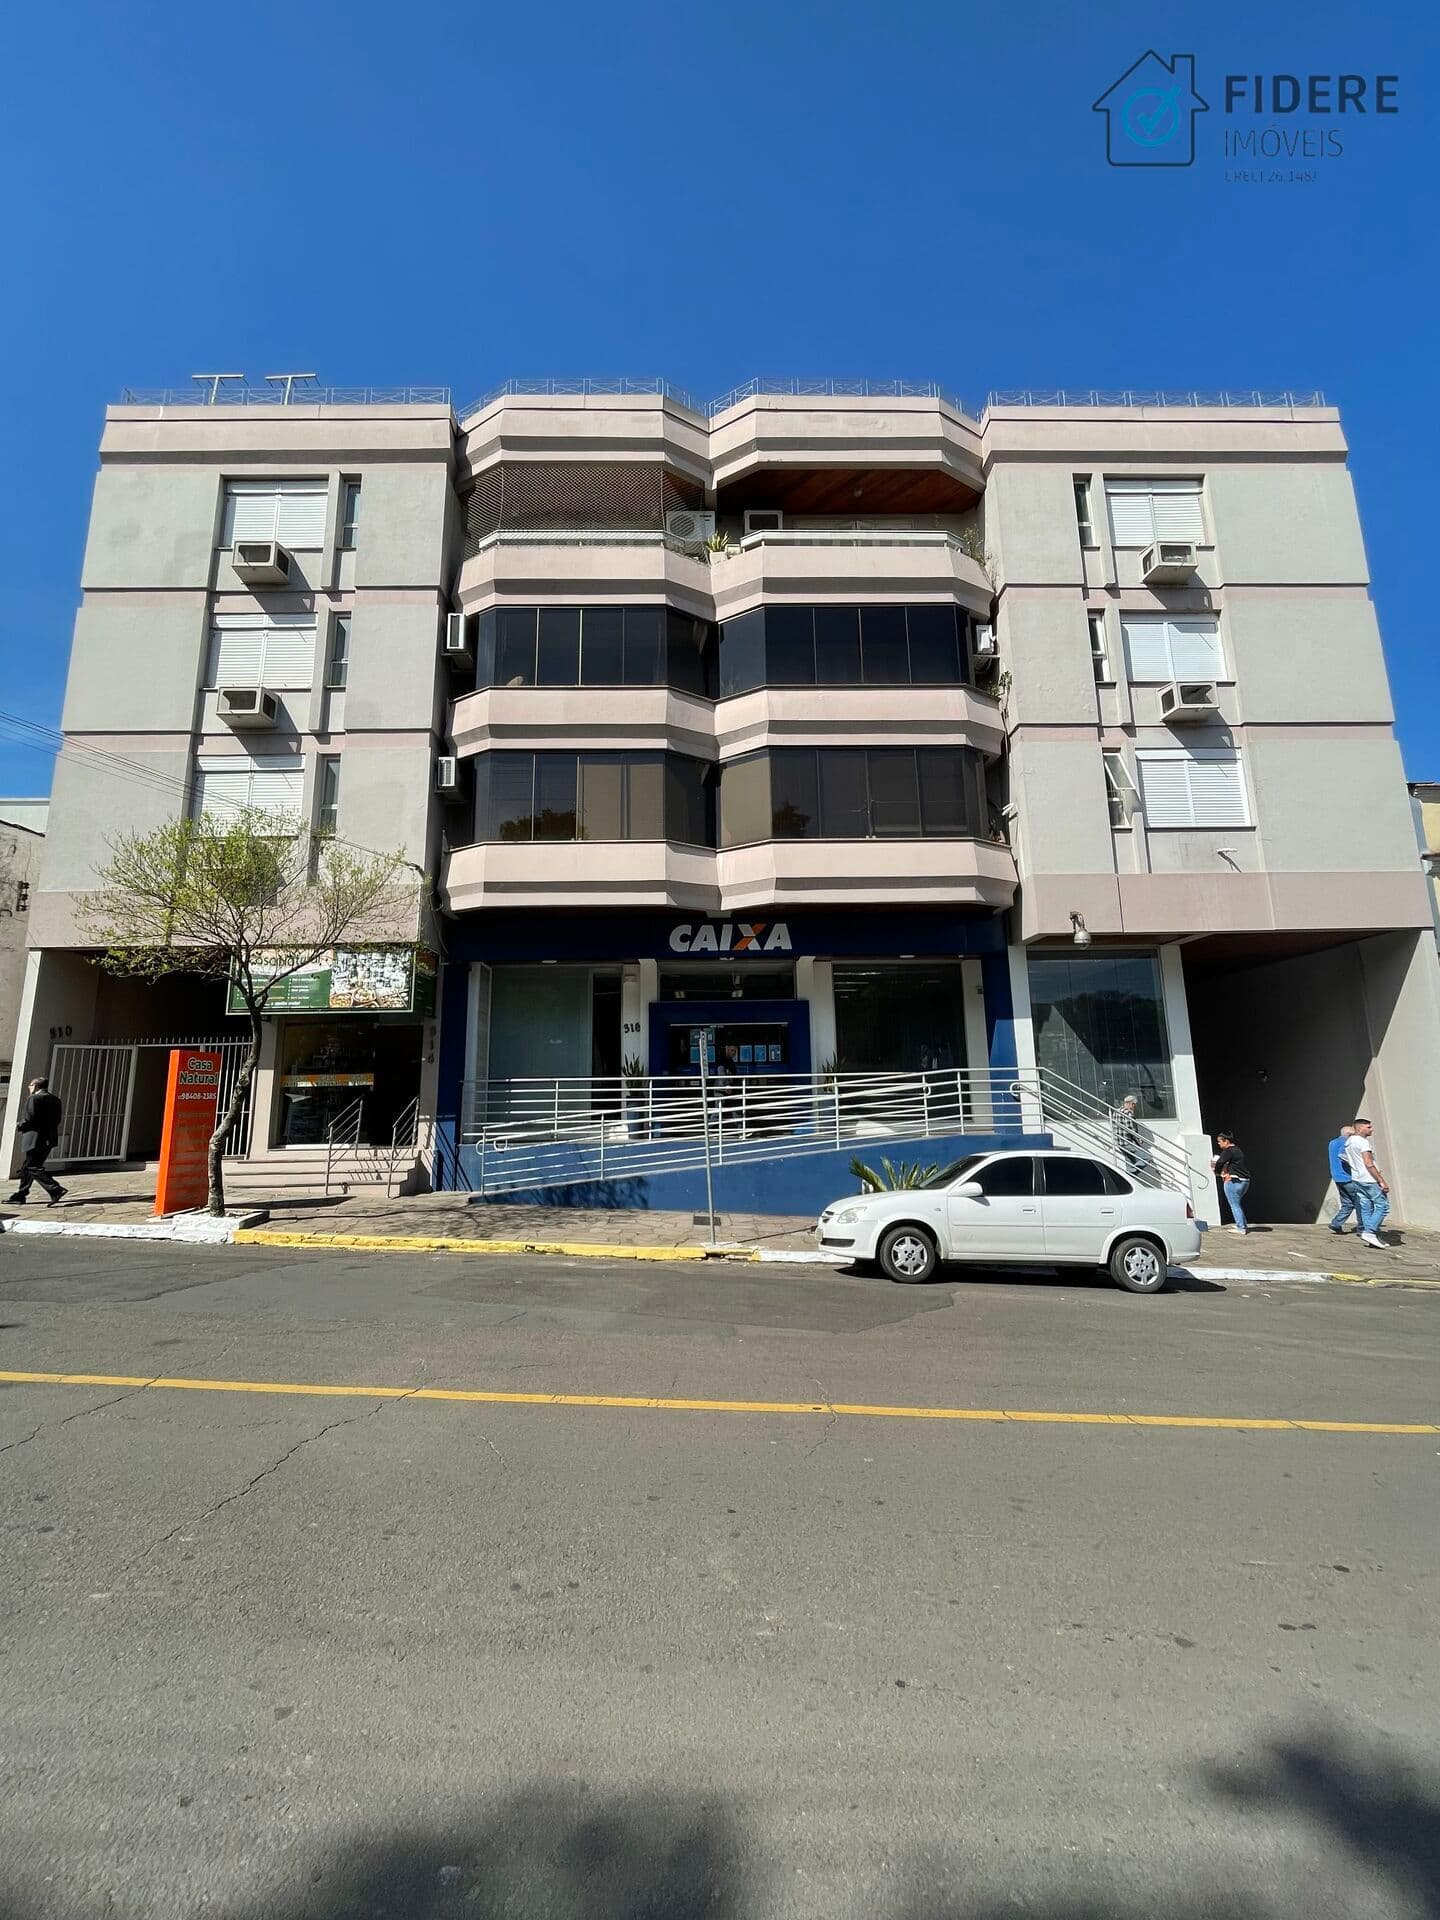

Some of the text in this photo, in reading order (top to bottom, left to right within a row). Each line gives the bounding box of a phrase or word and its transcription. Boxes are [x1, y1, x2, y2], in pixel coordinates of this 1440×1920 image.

[669, 923, 793, 952] CAIXA
[188, 1057, 213, 1070] Casa
[179, 1071, 218, 1085] Natural
